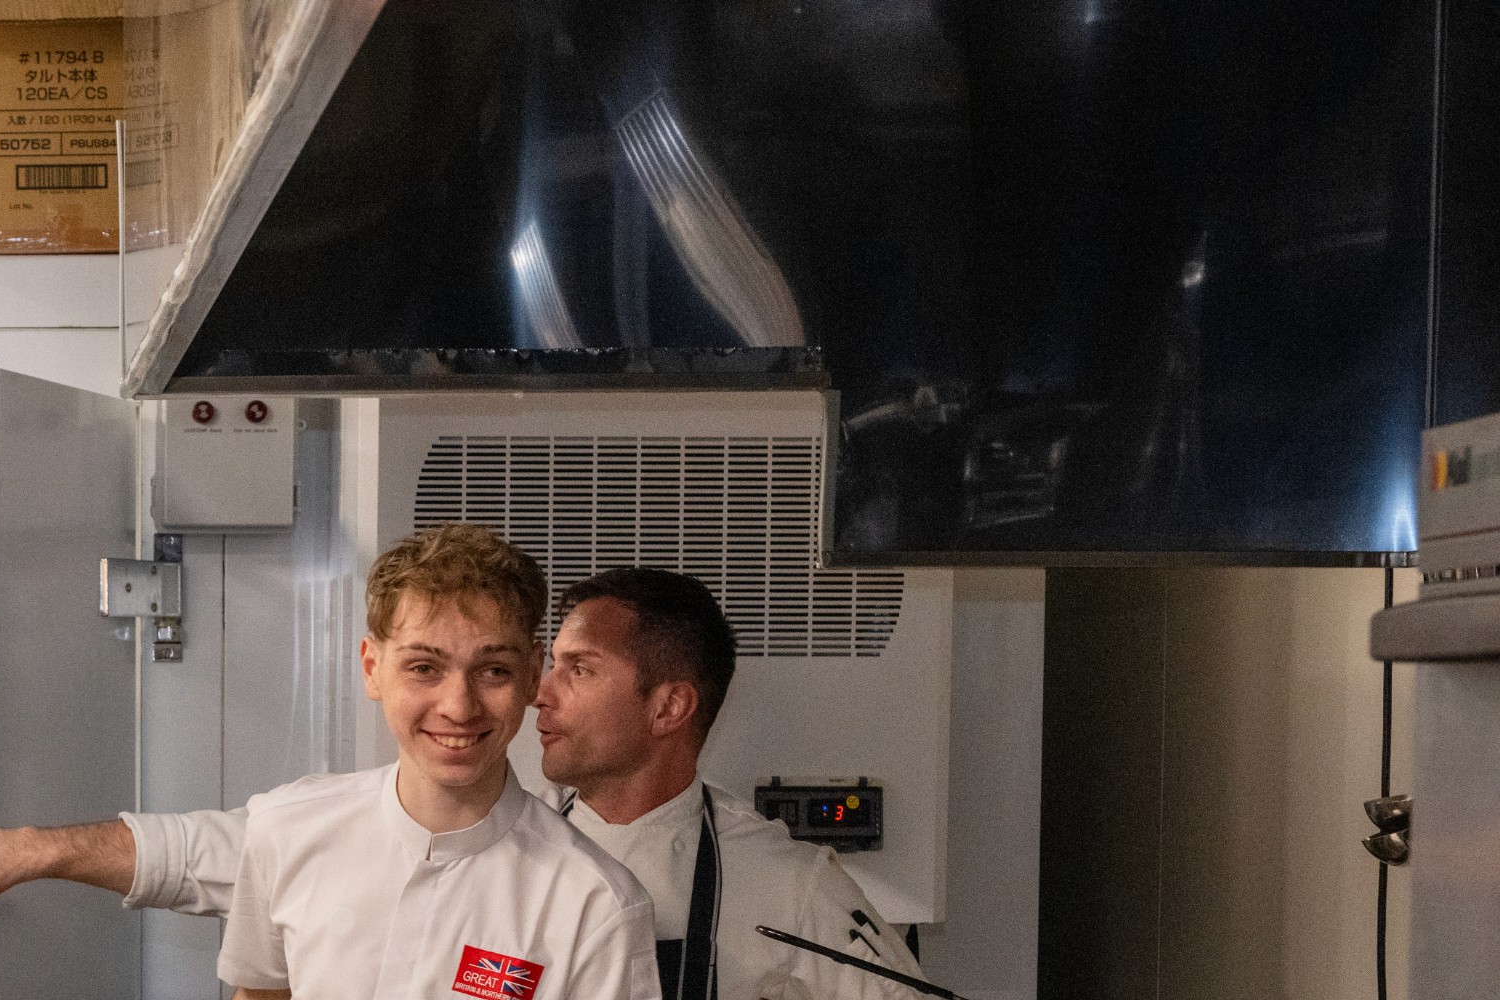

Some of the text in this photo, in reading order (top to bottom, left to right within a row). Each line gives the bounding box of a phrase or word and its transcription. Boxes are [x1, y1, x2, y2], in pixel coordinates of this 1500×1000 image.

[19, 51, 104, 64] #11794 B
[25, 68, 98, 83] タルト本体
[39, 115, 60, 125] 120
[0, 138, 51, 150] 50752
[835, 805, 844, 821] 3
[463, 970, 499, 988] GREAT
